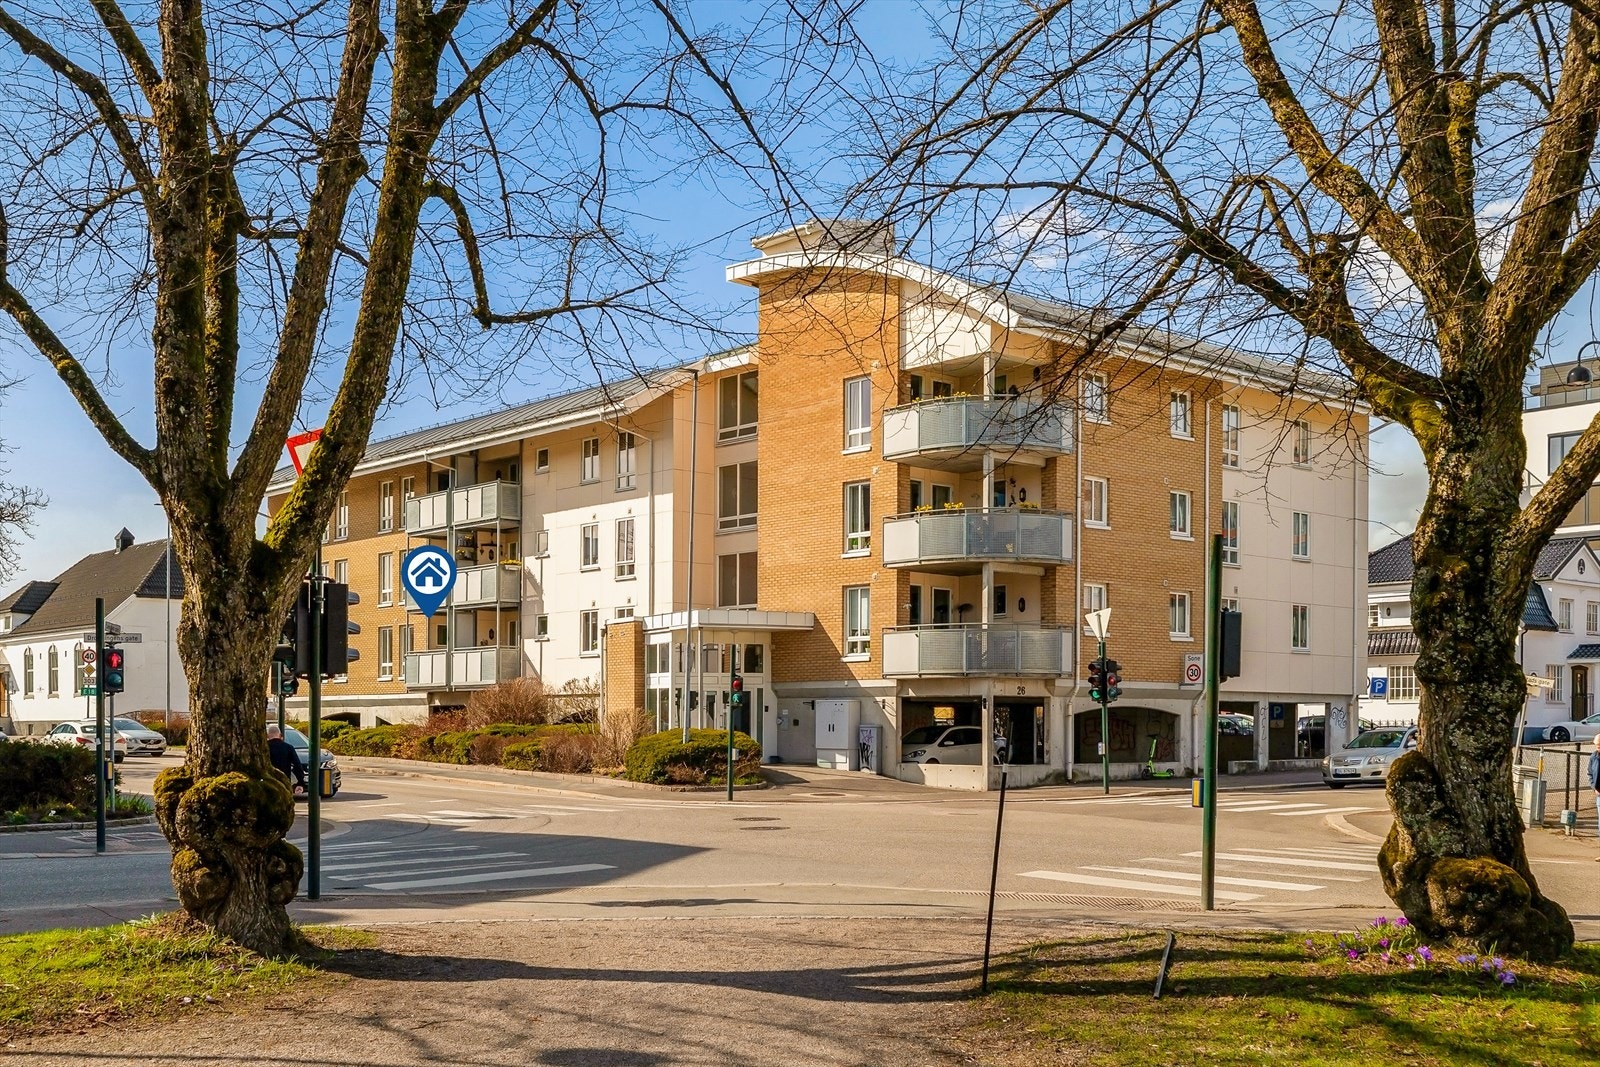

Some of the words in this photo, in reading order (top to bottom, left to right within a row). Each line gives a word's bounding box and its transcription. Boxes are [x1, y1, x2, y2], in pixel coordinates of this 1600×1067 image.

[84, 652, 95, 660] 40
[1189, 668, 1199, 678] 30
[1017, 686, 1026, 695] 26
